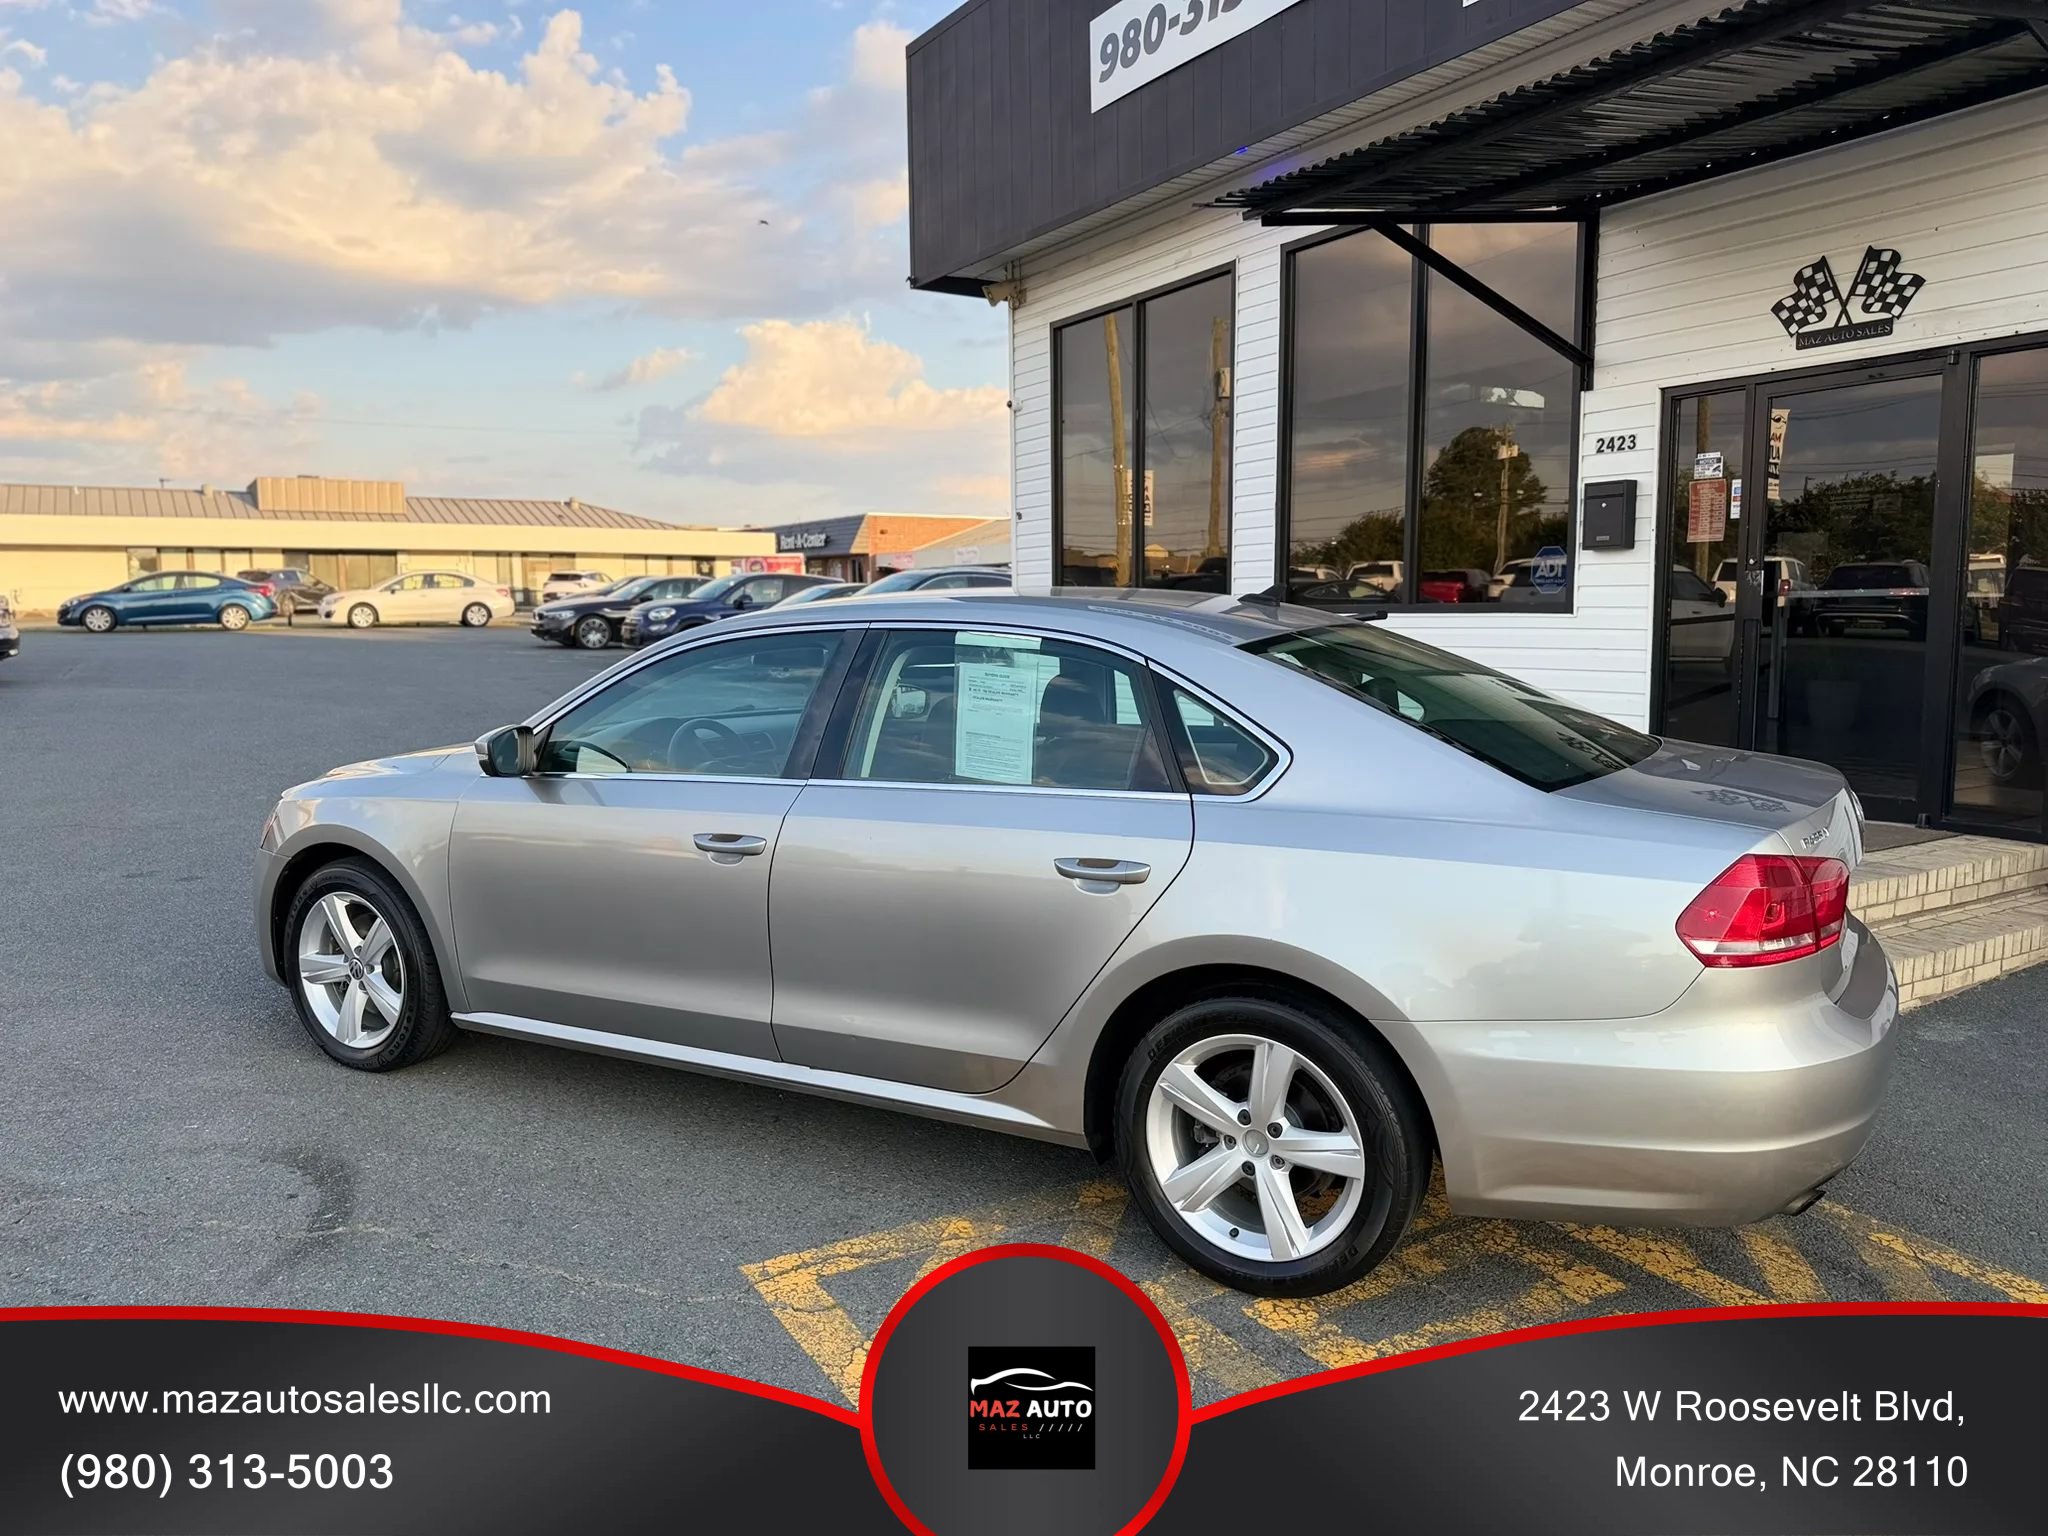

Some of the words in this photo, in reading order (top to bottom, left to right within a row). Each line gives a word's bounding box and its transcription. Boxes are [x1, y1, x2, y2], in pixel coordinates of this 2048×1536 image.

[1799, 335, 1822, 347] MAZ
[1824, 330, 1854, 342] AUTO
[1856, 324, 1891, 337] SALES
[1596, 434, 1637, 454] 2423
[780, 533, 826, 550] Rent-A-Center
[1535, 558, 1567, 578] ADT
